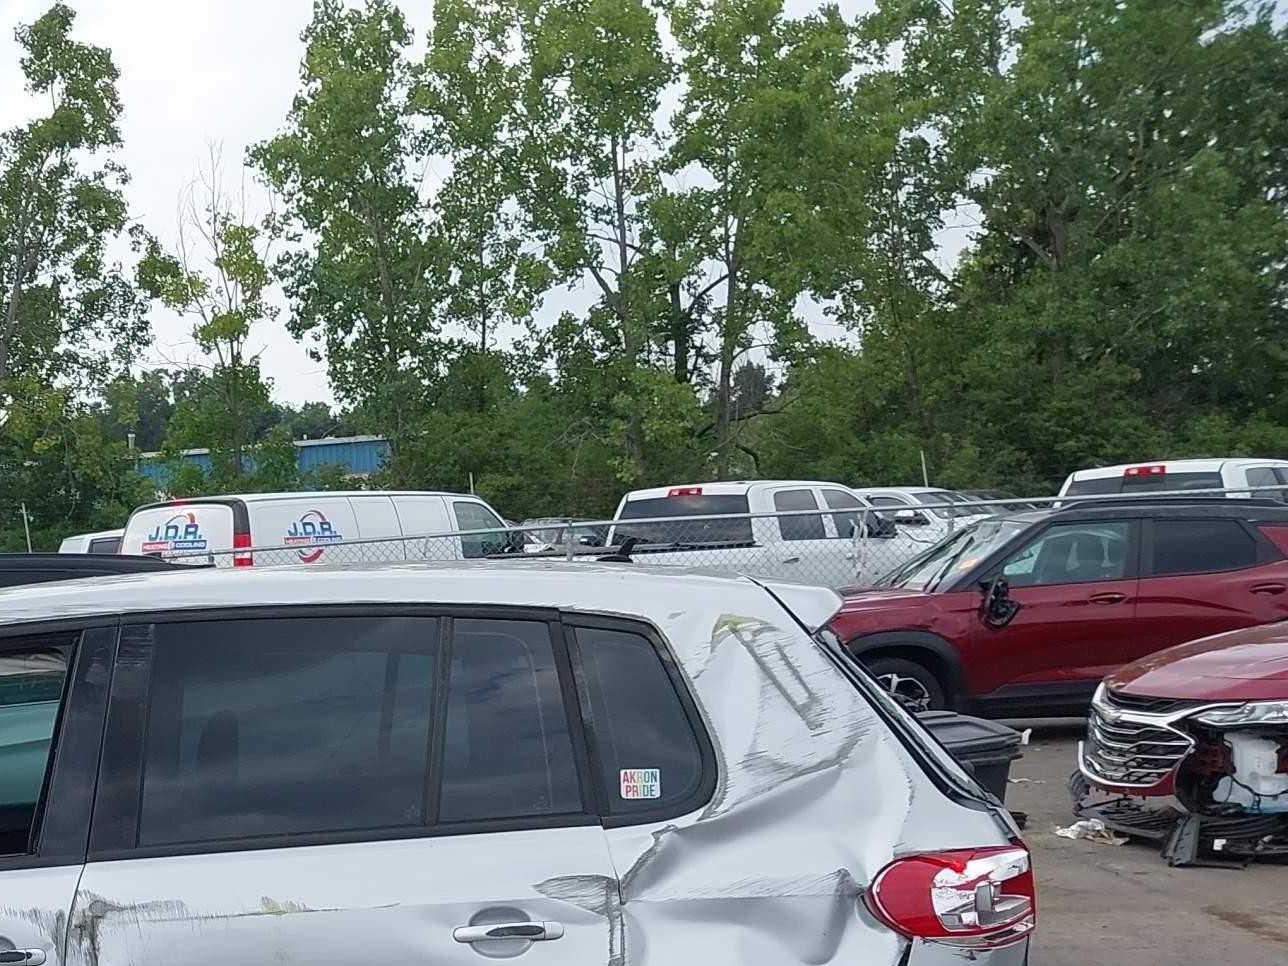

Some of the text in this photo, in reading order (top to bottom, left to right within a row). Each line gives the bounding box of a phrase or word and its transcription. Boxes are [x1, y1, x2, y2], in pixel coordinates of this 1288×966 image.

[149, 524, 203, 541] J.D.R.
[288, 522, 337, 536] J.D.R.
[176, 541, 206, 549] COOLING
[623, 771, 658, 784] AKRON
[625, 785, 656, 798] PRIDE
